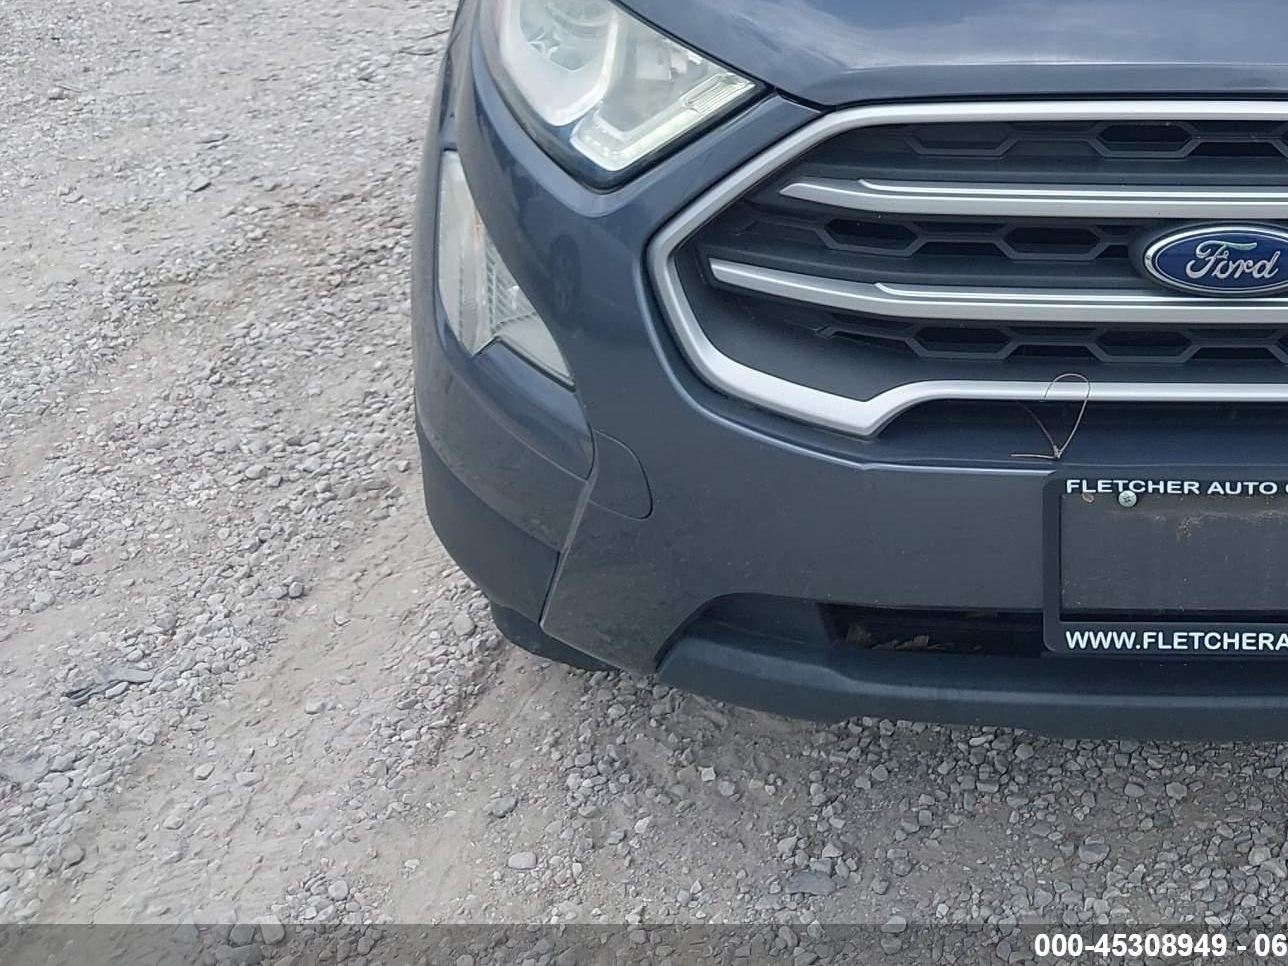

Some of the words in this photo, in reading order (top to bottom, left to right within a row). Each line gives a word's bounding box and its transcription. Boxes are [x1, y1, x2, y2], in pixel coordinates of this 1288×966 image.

[1185, 240, 1281, 279] Ford
[1066, 479, 1200, 494] FLETCHER
[1207, 481, 1278, 495] AUTO
